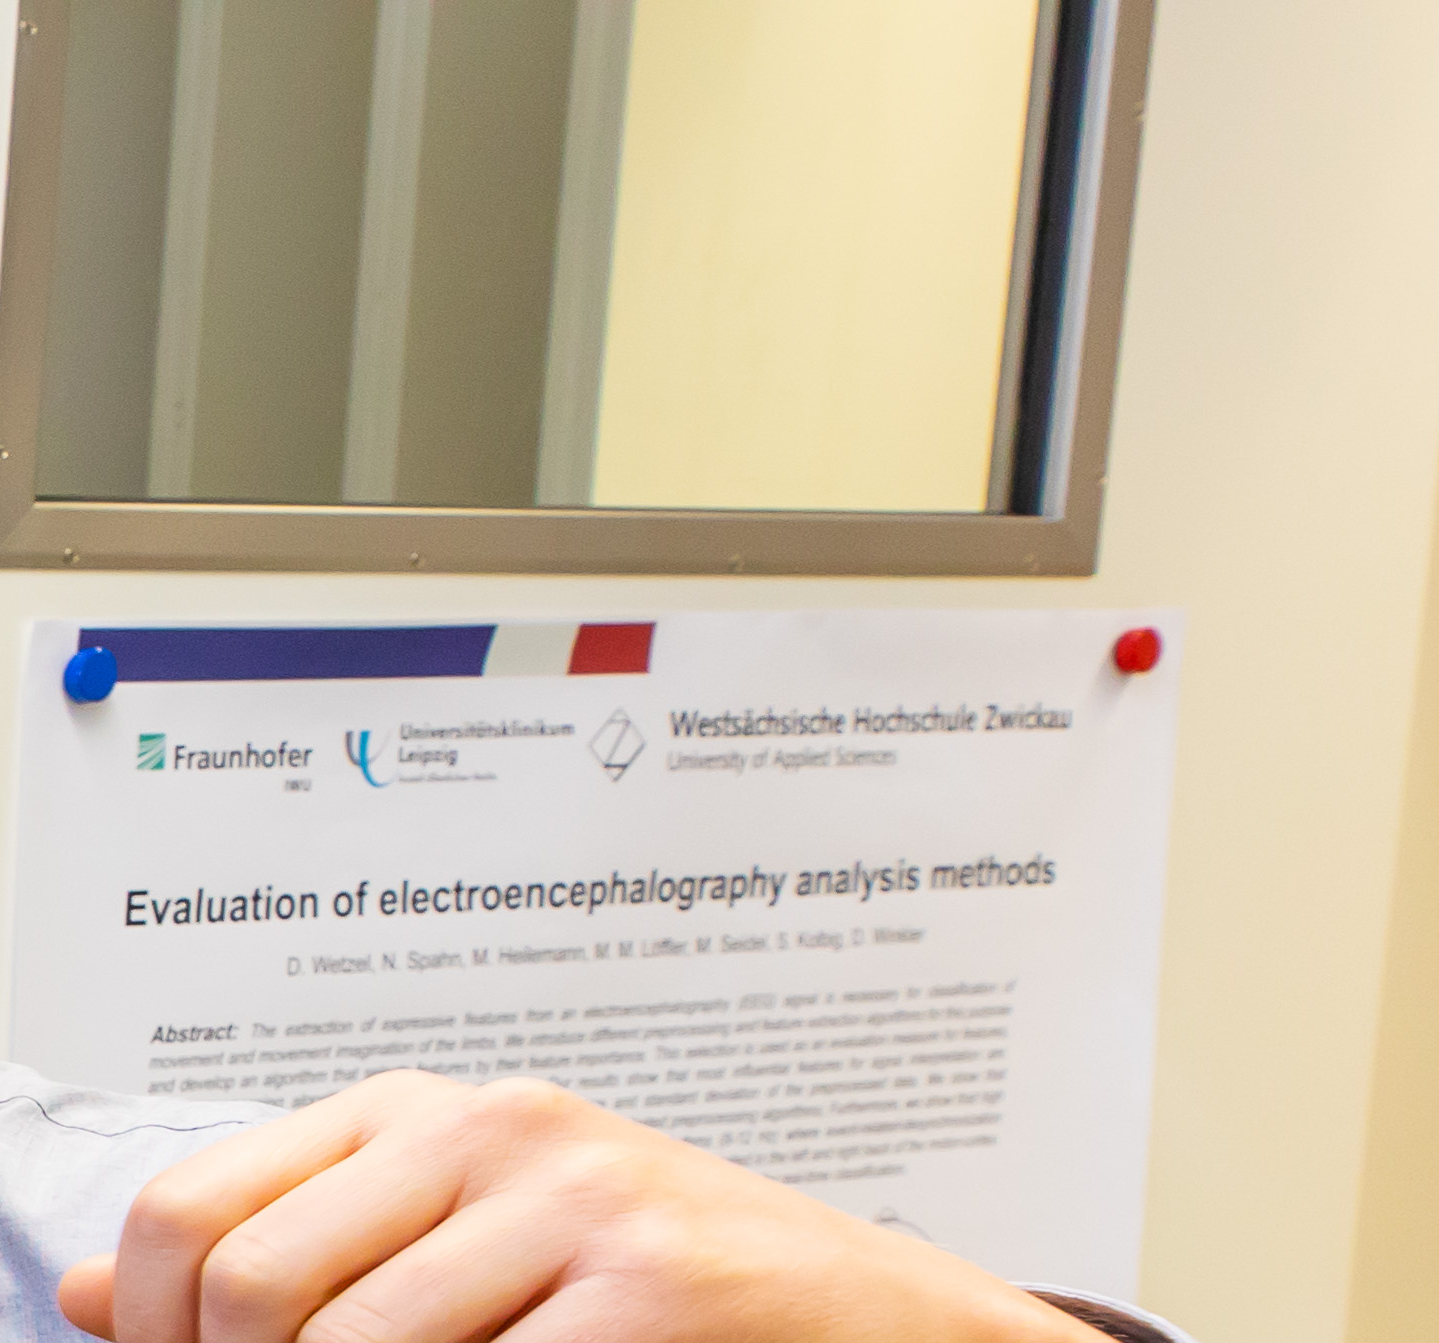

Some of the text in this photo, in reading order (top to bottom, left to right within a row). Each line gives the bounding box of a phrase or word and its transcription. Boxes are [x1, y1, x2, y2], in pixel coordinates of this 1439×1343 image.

[669, 702, 1073, 738] Westsächsische Hochschule Zwickau
[173, 740, 314, 770] Fraunhofer
[123, 853, 1057, 929] Evaluation of electroencephalography analysis methods
